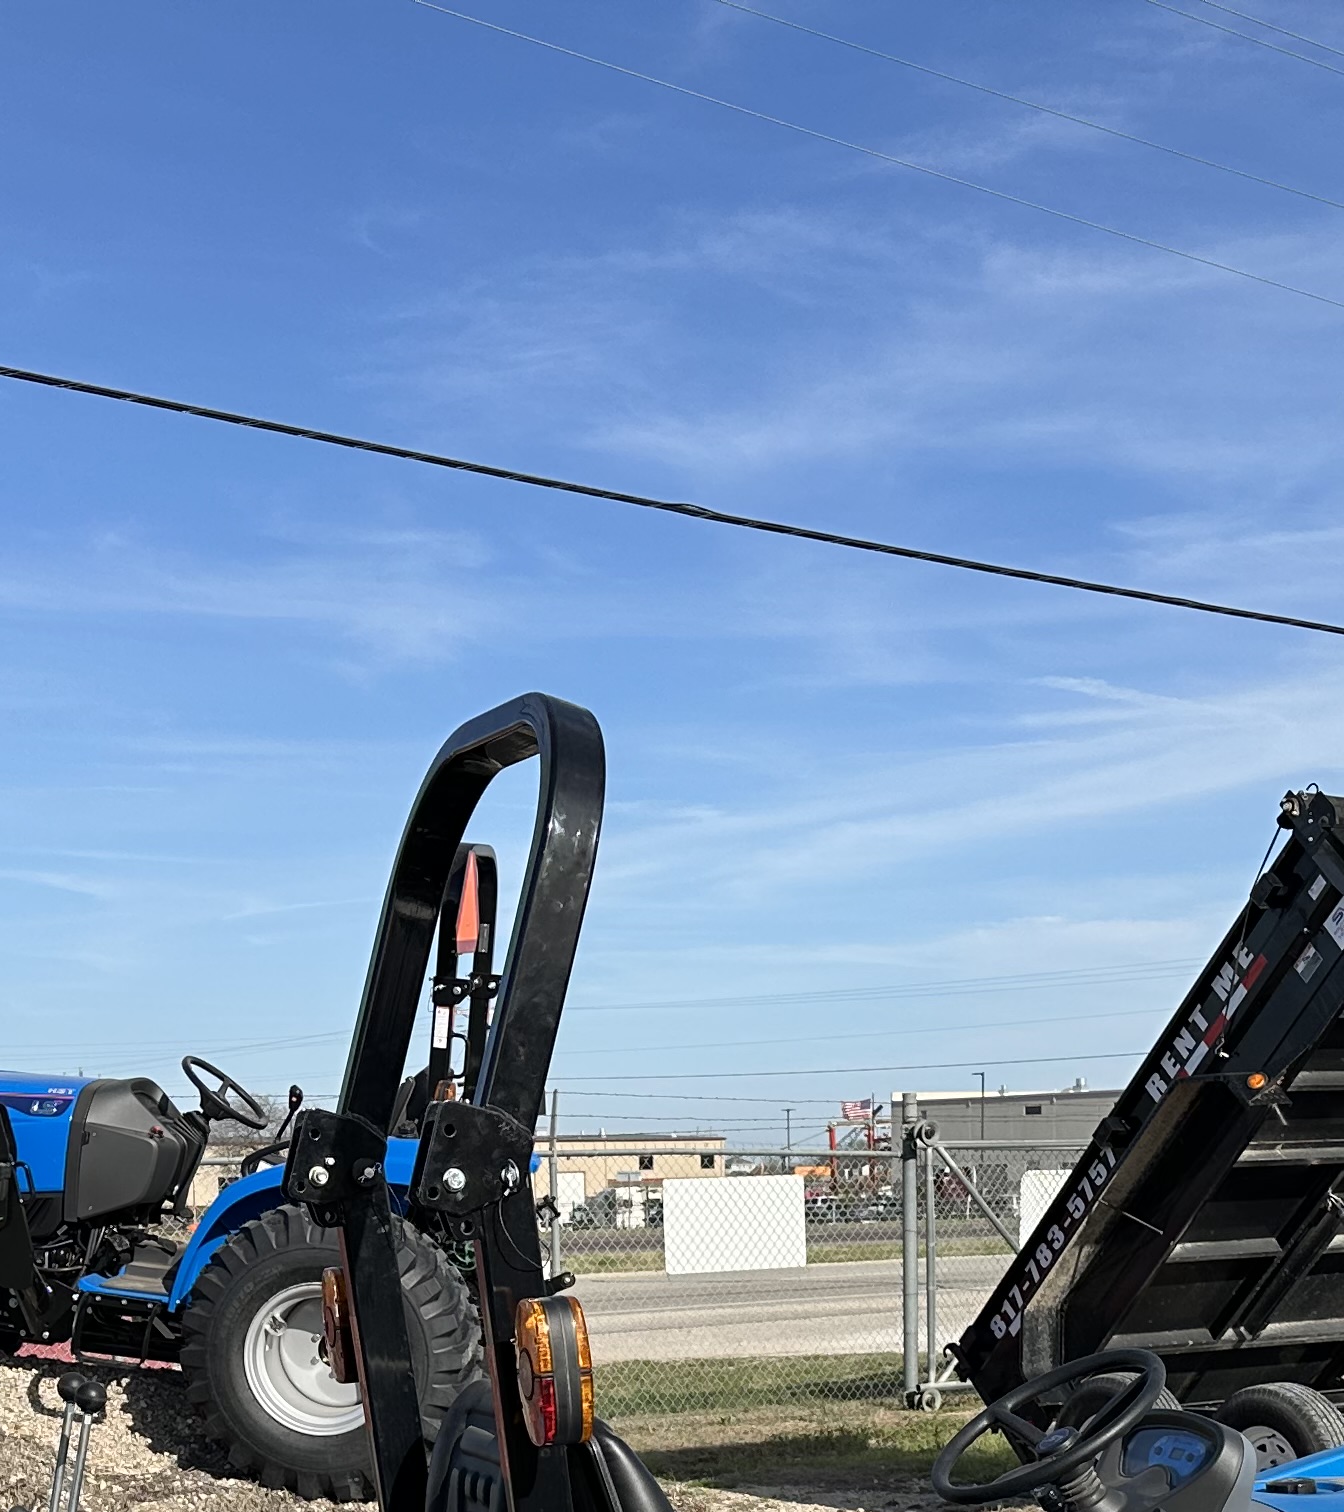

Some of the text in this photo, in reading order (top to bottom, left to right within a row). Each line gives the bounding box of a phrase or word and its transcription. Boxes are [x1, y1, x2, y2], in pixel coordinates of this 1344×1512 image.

[1145, 940, 1254, 1103] RENT ME
[990, 1145, 1117, 1339] 817-783-5757
